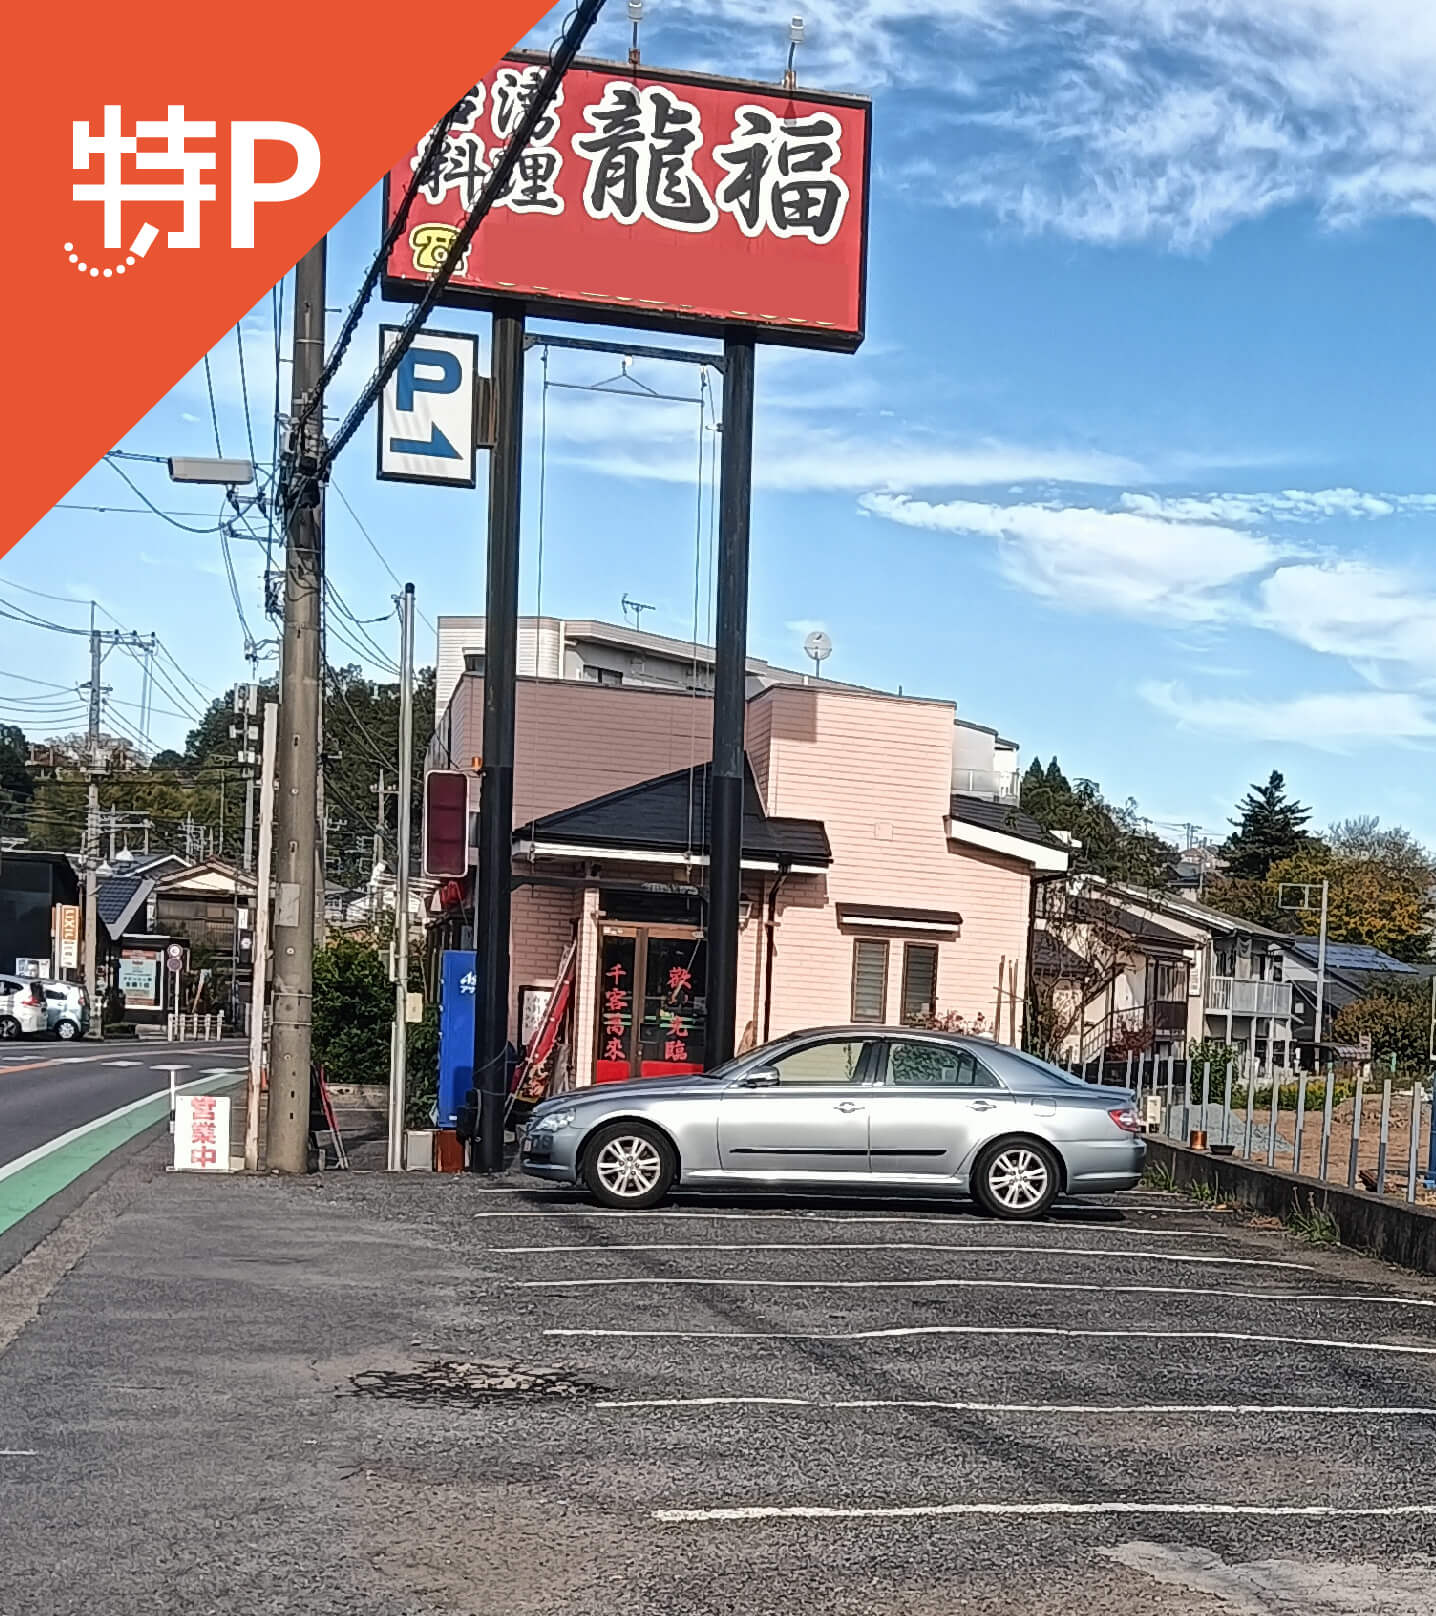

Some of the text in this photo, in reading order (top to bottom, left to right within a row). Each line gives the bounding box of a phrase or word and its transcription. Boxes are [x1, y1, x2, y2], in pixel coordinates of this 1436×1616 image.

[414, 138, 560, 209] 料理
[576, 86, 843, 239] 龍福
[396, 346, 463, 412] P
[191, 1096, 216, 1168] 営業中
